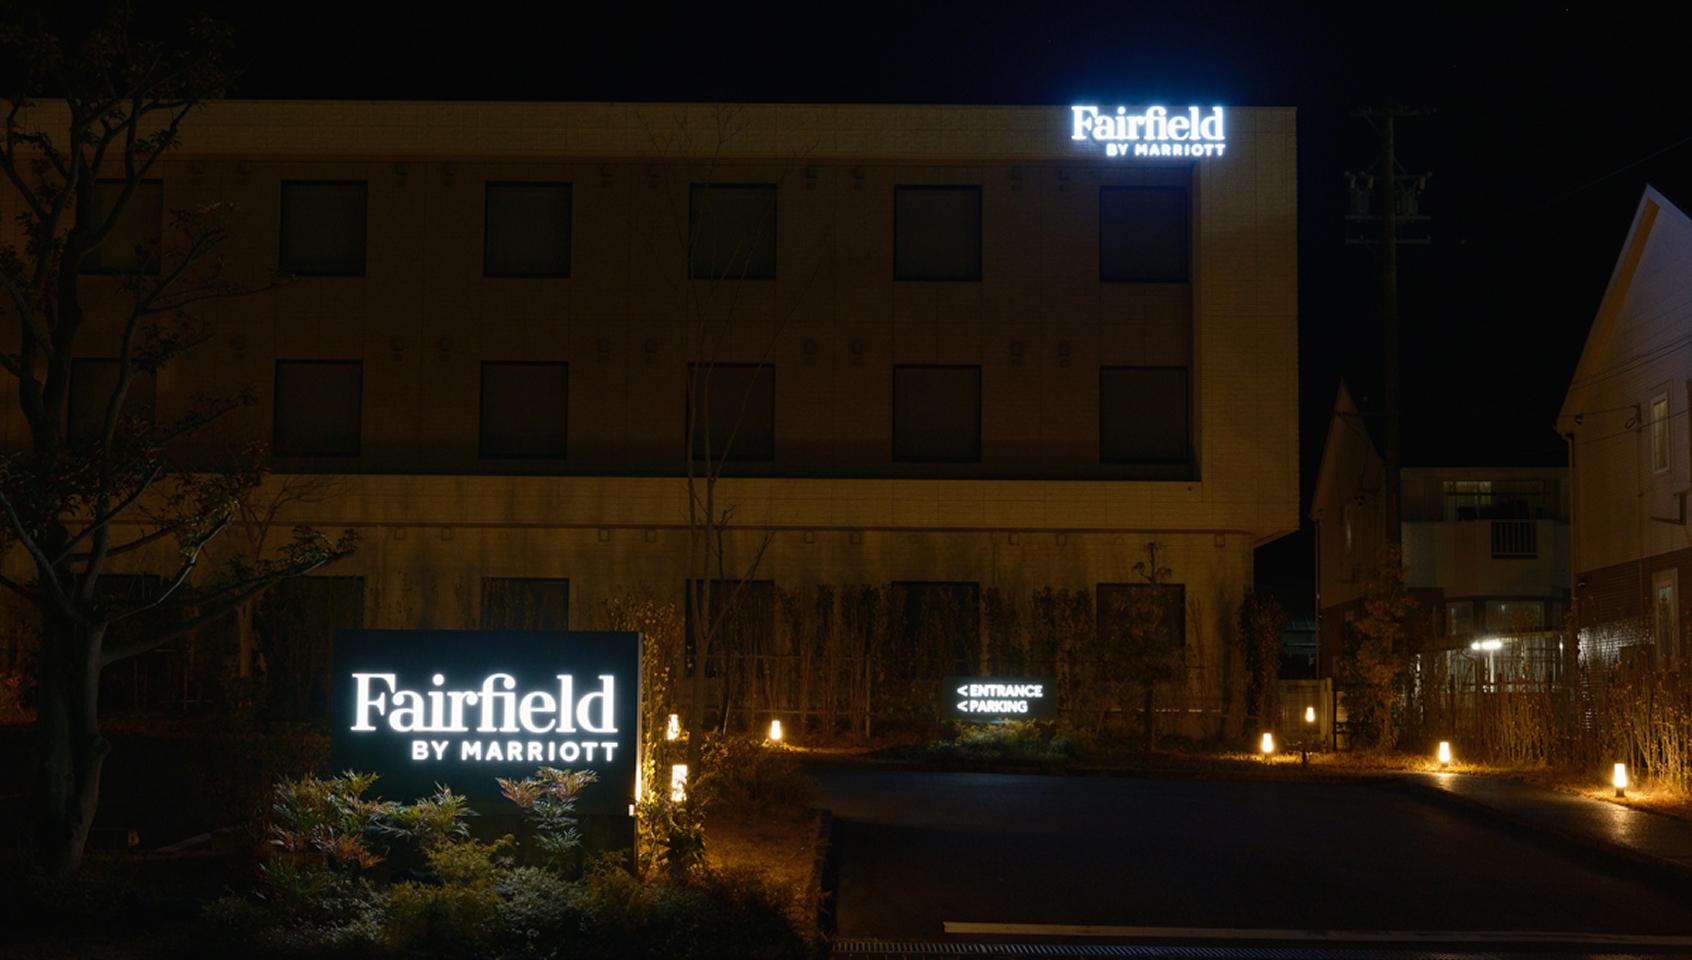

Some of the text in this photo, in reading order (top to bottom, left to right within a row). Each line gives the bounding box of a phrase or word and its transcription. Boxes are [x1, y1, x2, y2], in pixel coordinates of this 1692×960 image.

[1071, 106, 1225, 140] Fairfield
[1106, 143, 1226, 156] BY MARRIOTT
[969, 684, 1043, 698] ENTRANCE
[350, 673, 618, 733] Fairfield
[969, 700, 1028, 713] PARKING
[412, 741, 619, 761] BY MARRIOTT
